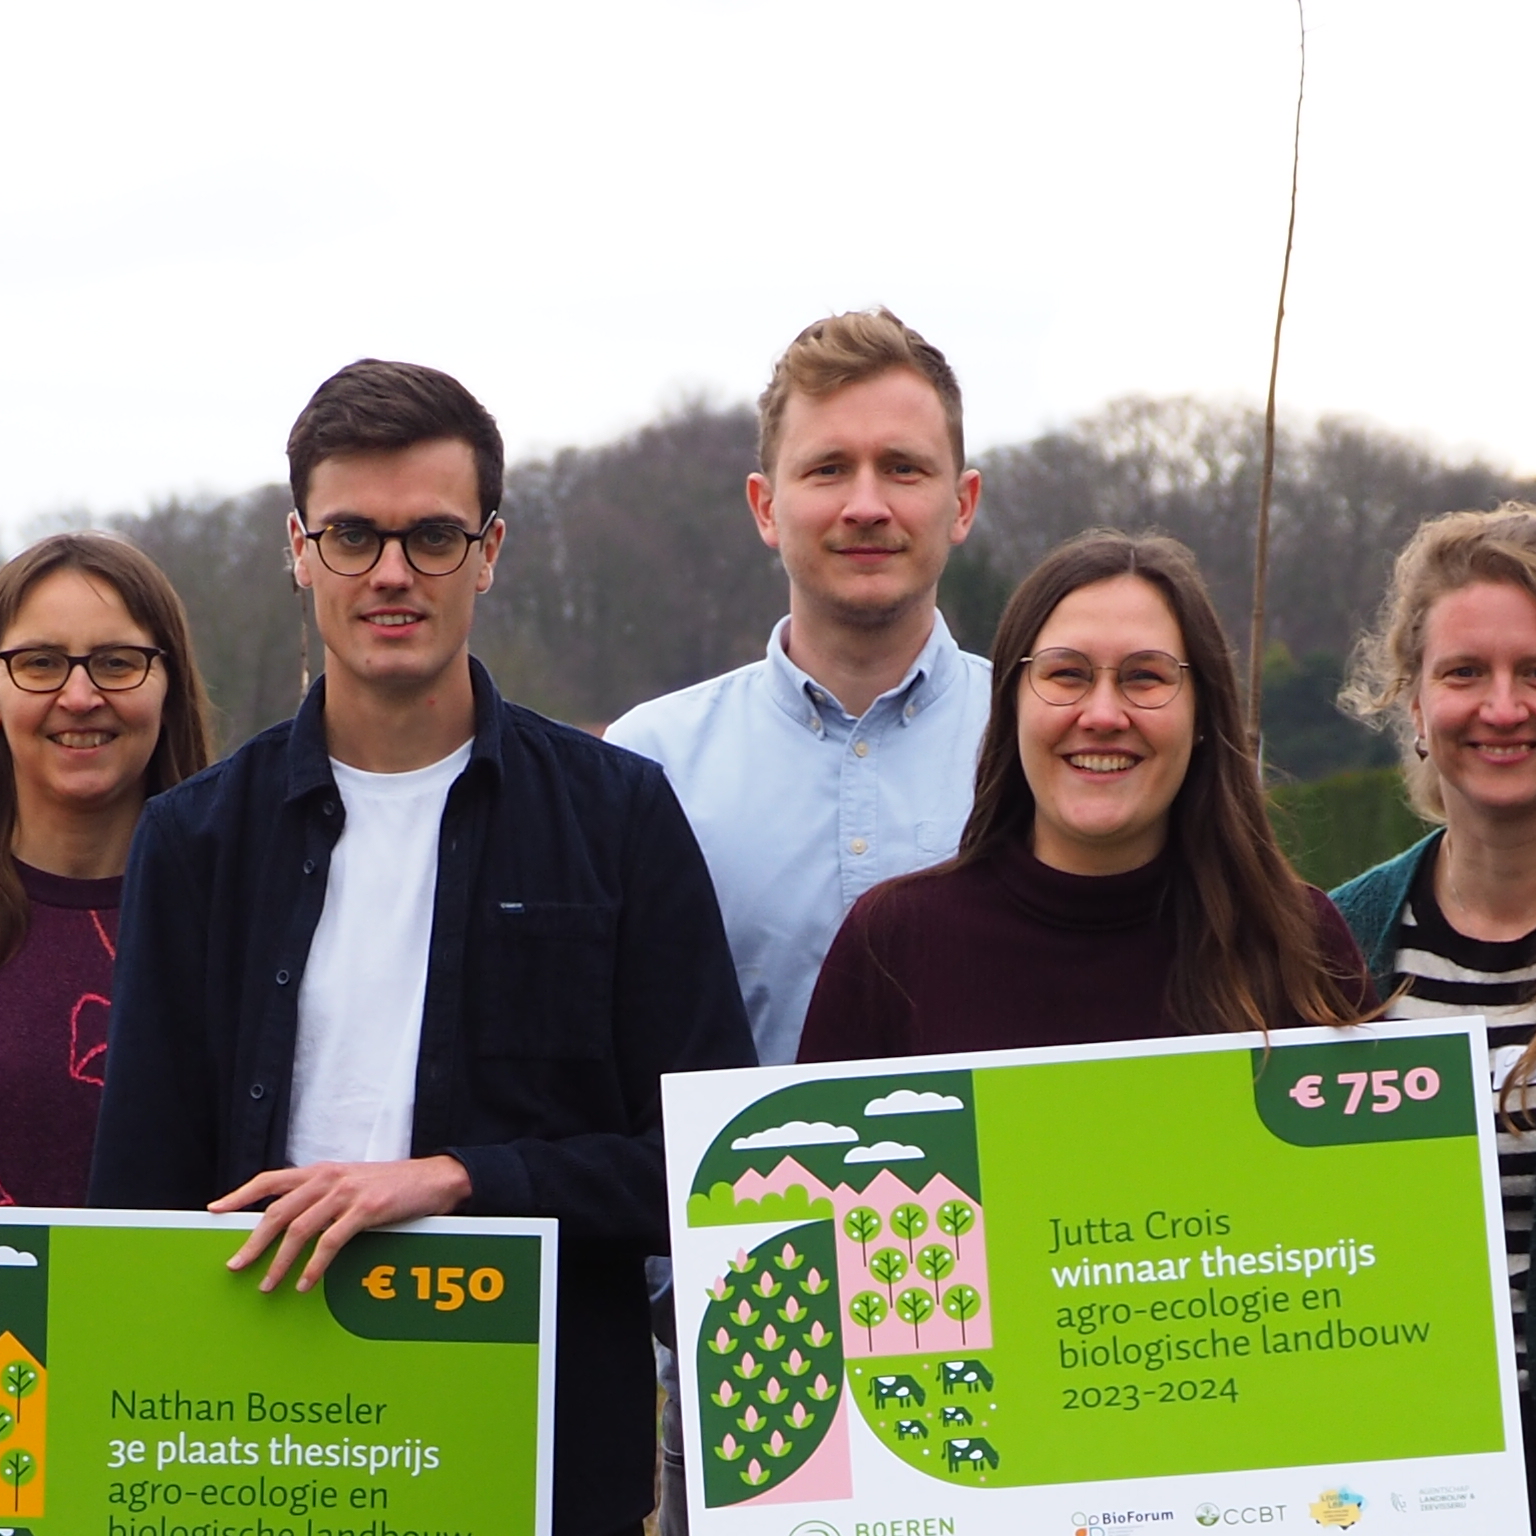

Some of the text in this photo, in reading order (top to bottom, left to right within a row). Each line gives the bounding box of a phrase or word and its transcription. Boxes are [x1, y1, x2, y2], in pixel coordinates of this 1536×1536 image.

[1289, 1066, 1441, 1115] € 750
[1048, 1210, 1232, 1254] Jutta Crois
[1050, 1238, 1377, 1288] winnaar thesisprijs
[361, 1265, 506, 1312] € 150
[1055, 1286, 1342, 1334] agro-ecologie en
[1058, 1318, 1431, 1372] biologische landbouw
[110, 1389, 389, 1426] Nathan Bosseler
[1062, 1377, 1240, 1411] 2023-2024
[107, 1432, 441, 1477] 3e plaats thesisprijs
[107, 1476, 389, 1516] agro-ecologie en
[1102, 1510, 1174, 1525] BioForum
[1223, 1504, 1287, 1525] CCBT
